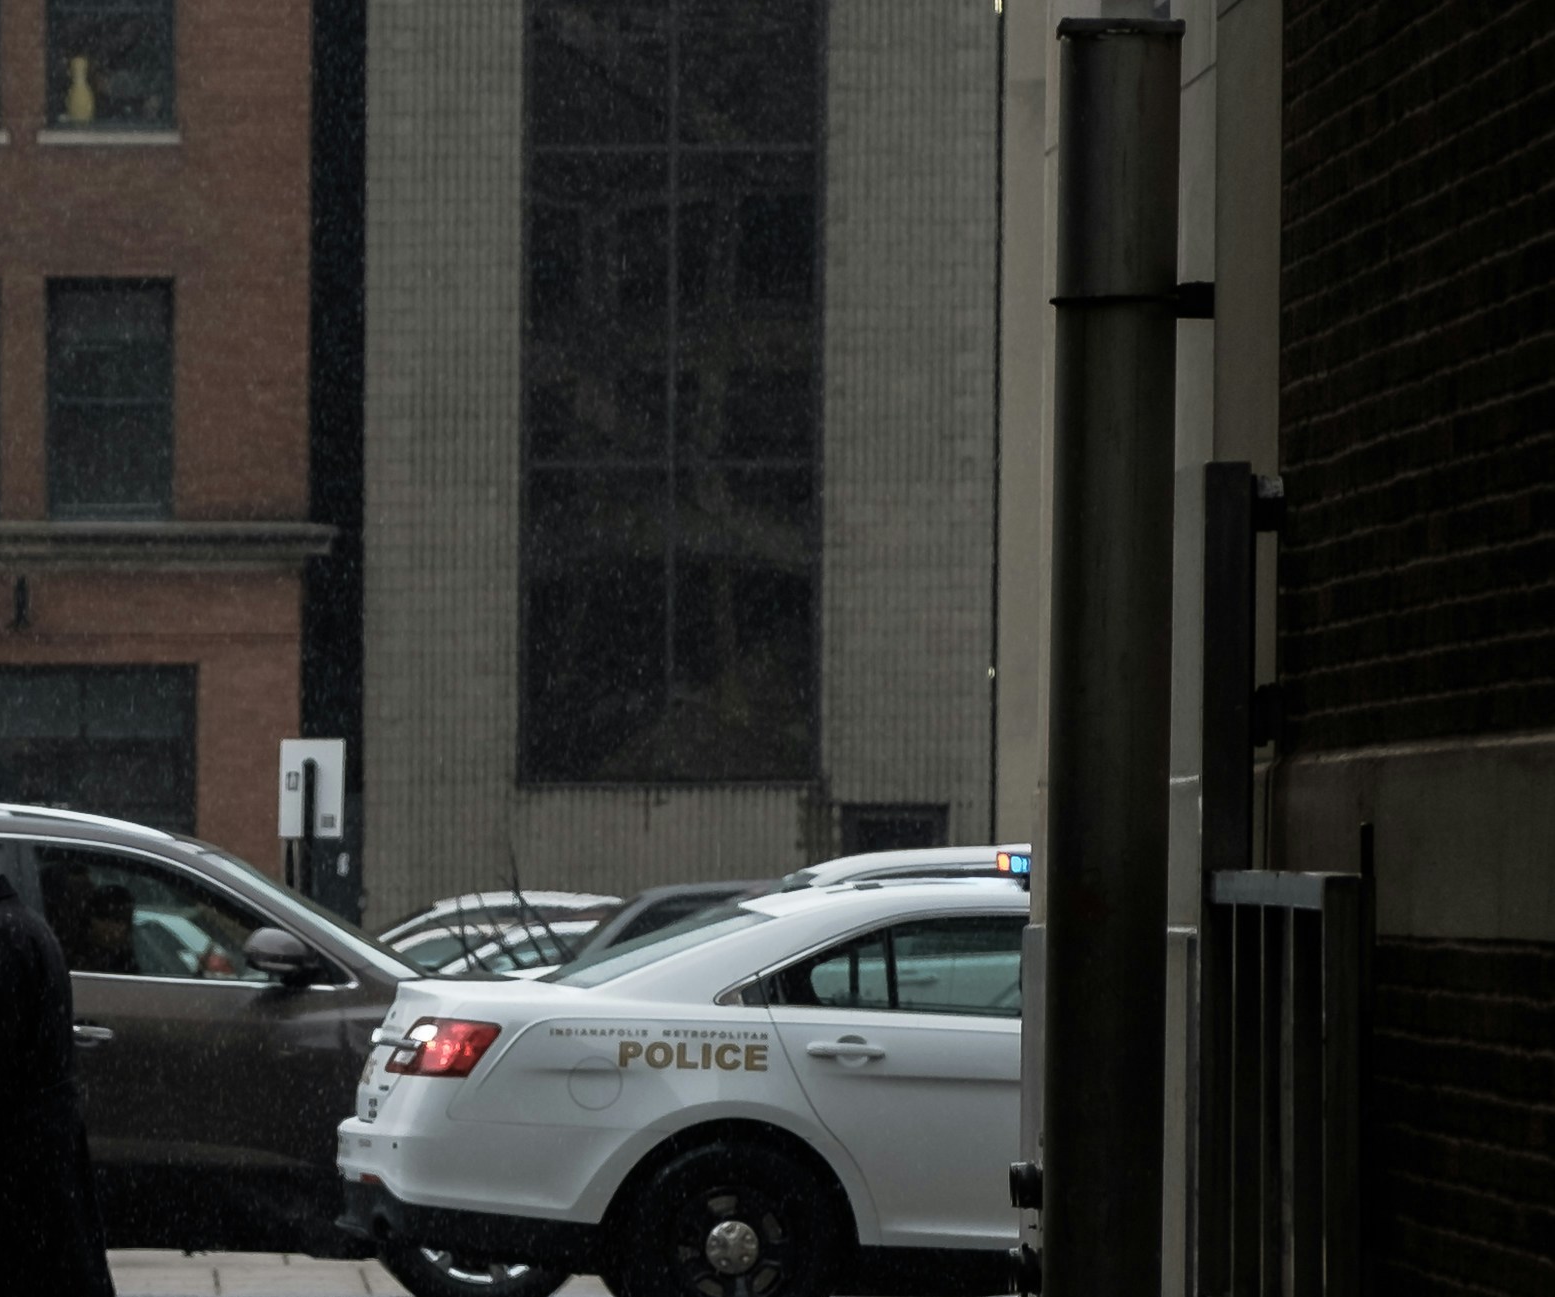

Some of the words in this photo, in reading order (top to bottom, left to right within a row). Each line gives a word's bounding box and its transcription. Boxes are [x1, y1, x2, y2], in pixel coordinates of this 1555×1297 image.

[549, 1028, 648, 1037] INDIANAPOLIS
[662, 1029, 769, 1040] METROPOLITAN
[618, 1040, 769, 1072] POLICE
